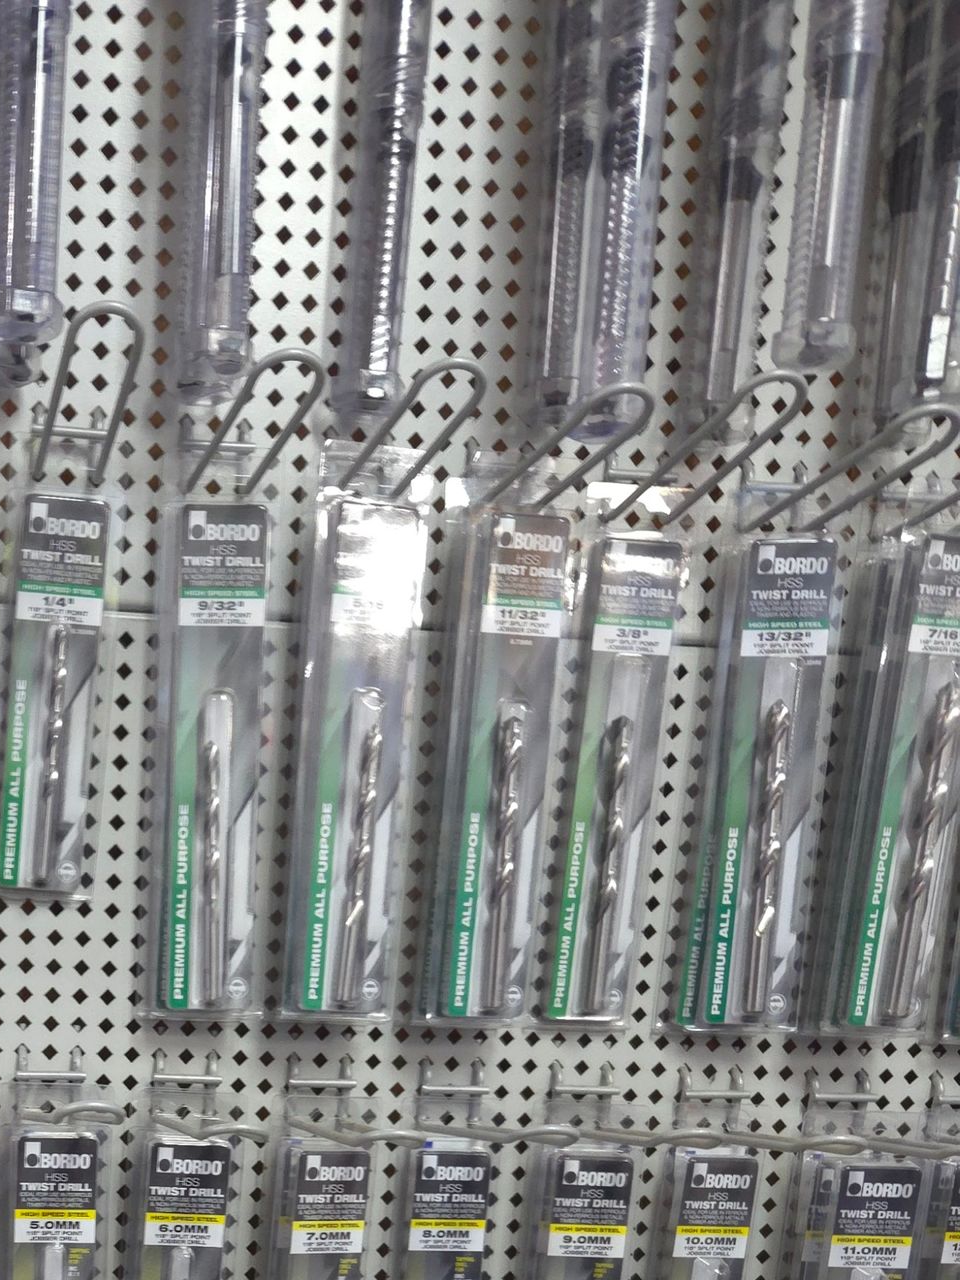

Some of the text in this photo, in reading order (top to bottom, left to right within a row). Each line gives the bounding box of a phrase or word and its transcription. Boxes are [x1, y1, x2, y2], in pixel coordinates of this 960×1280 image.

[48, 518, 101, 539] BORDO
[775, 557, 828, 574] BORDO
[752, 590, 827, 600] TWIST DRILL
[919, 584, 953, 596] TWIST
[711, 827, 738, 1015] PREMIUM ALL PURPOSE
[40, 1153, 91, 1169] BORDO
[173, 1159, 222, 1176] BORDO
[578, 1171, 626, 1187] BORDO
[862, 1183, 913, 1198] BORDO
[866, 1201, 888, 1210] HSS
[840, 1210, 910, 1219] TWIST DRILL
[29, 1221, 80, 1230] 5.0MM
[159, 1224, 209, 1234] 6.0MM
[306, 1231, 351, 1240] 7.0MM
[422, 1230, 470, 1238] 8.0MM
[562, 1235, 611, 1245] 9.0MM
[685, 1236, 737, 1246] 10.0MM
[842, 1247, 897, 1256] 11.0MM
